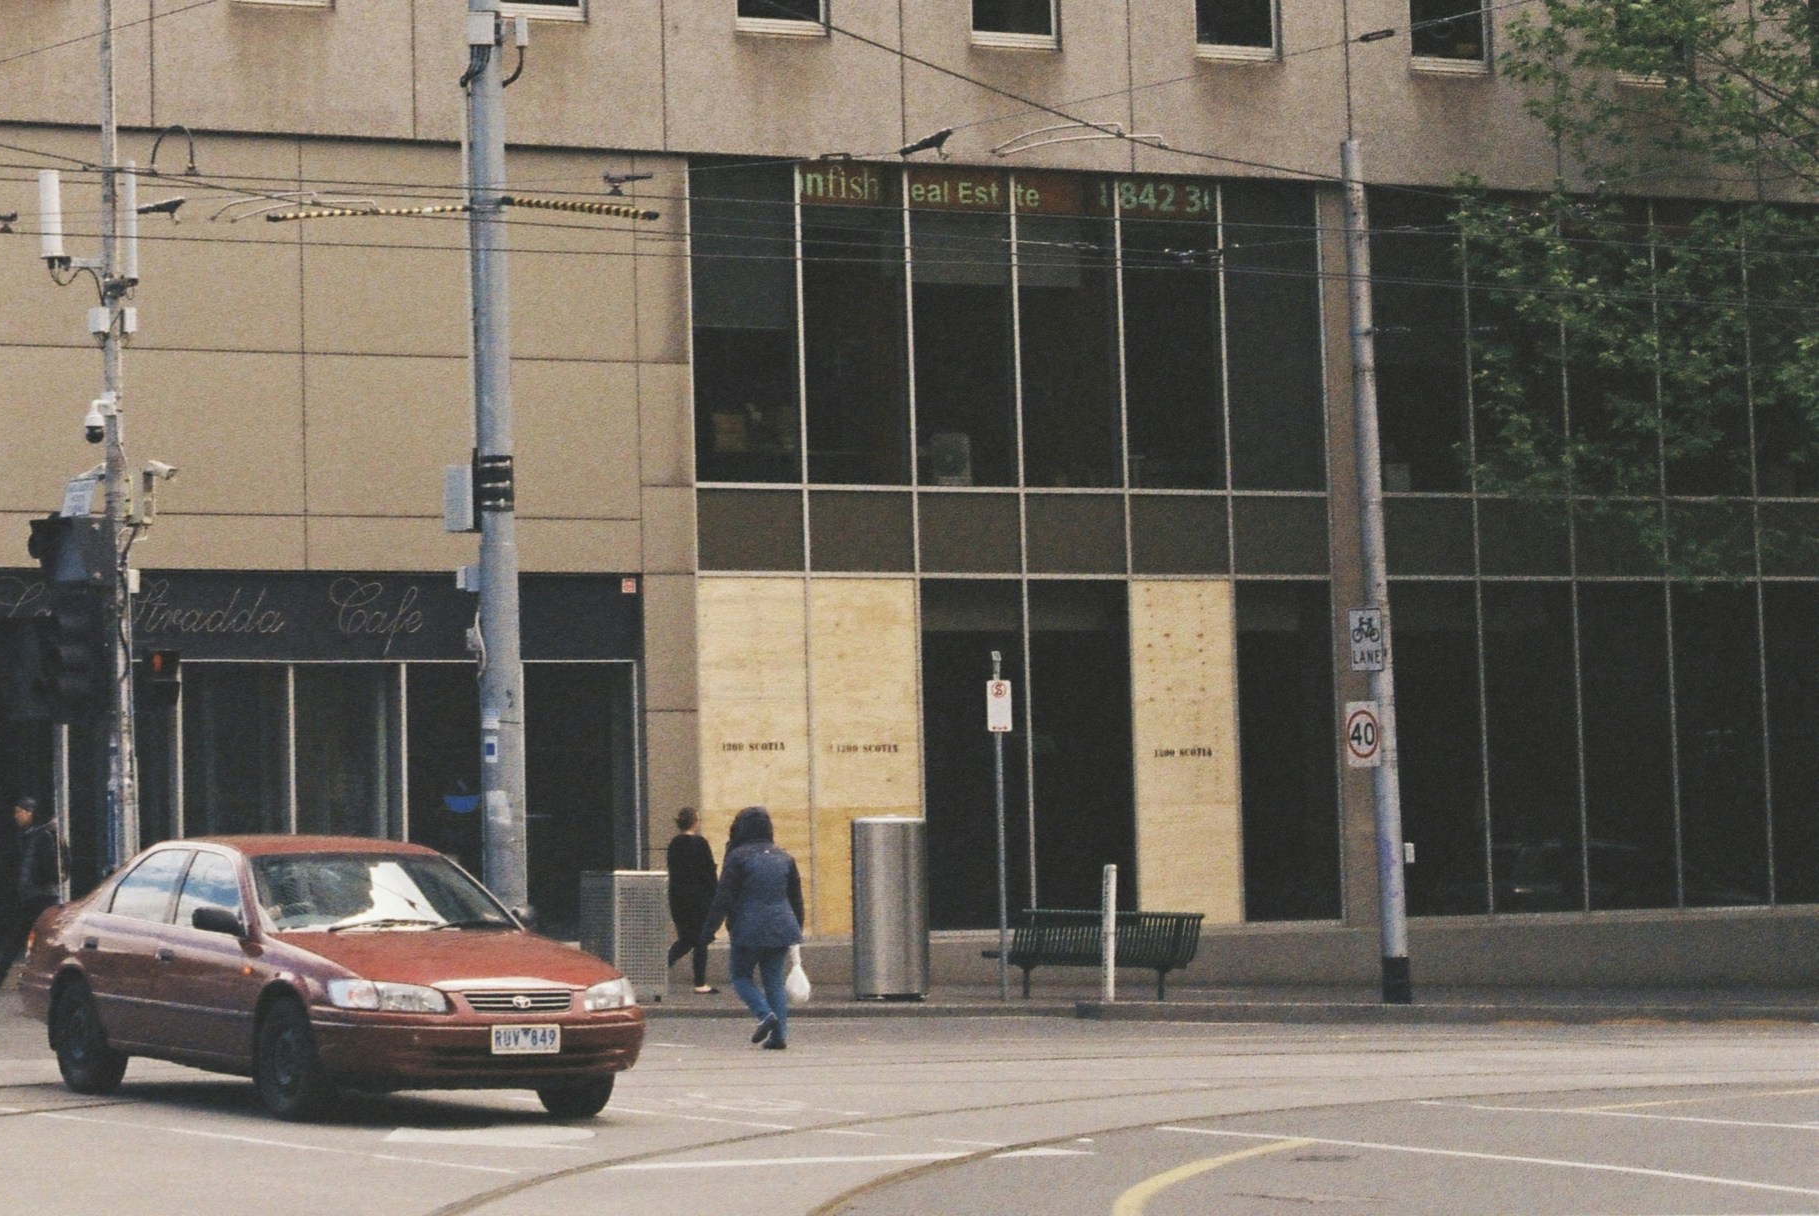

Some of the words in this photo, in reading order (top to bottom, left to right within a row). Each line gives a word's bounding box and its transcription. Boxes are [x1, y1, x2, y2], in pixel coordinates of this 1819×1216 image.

[910, 181, 950, 204] eal
[1352, 650, 1381, 665] LANE
[1350, 722, 1375, 746] 40
[749, 741, 786, 751] SCOTIA
[863, 744, 899, 753] SCOTIA
